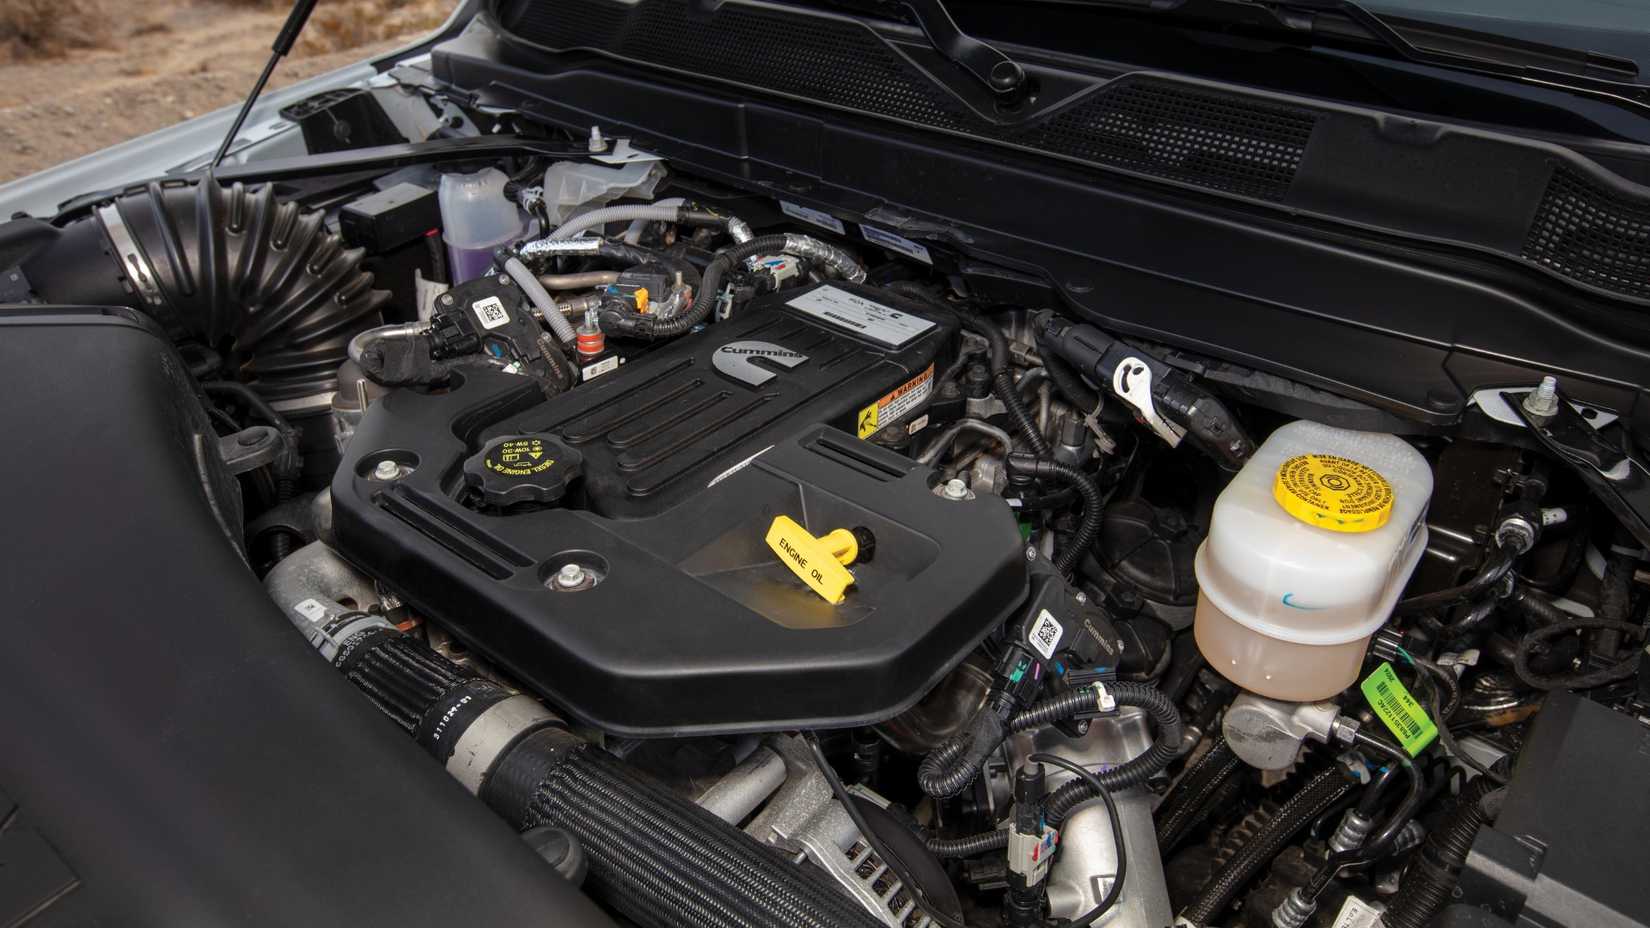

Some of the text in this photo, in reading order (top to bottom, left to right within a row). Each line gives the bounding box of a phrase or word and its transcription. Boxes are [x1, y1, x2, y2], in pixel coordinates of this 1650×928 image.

[898, 374, 928, 395] WARNING
[779, 538, 823, 584] ENGINE OIL
